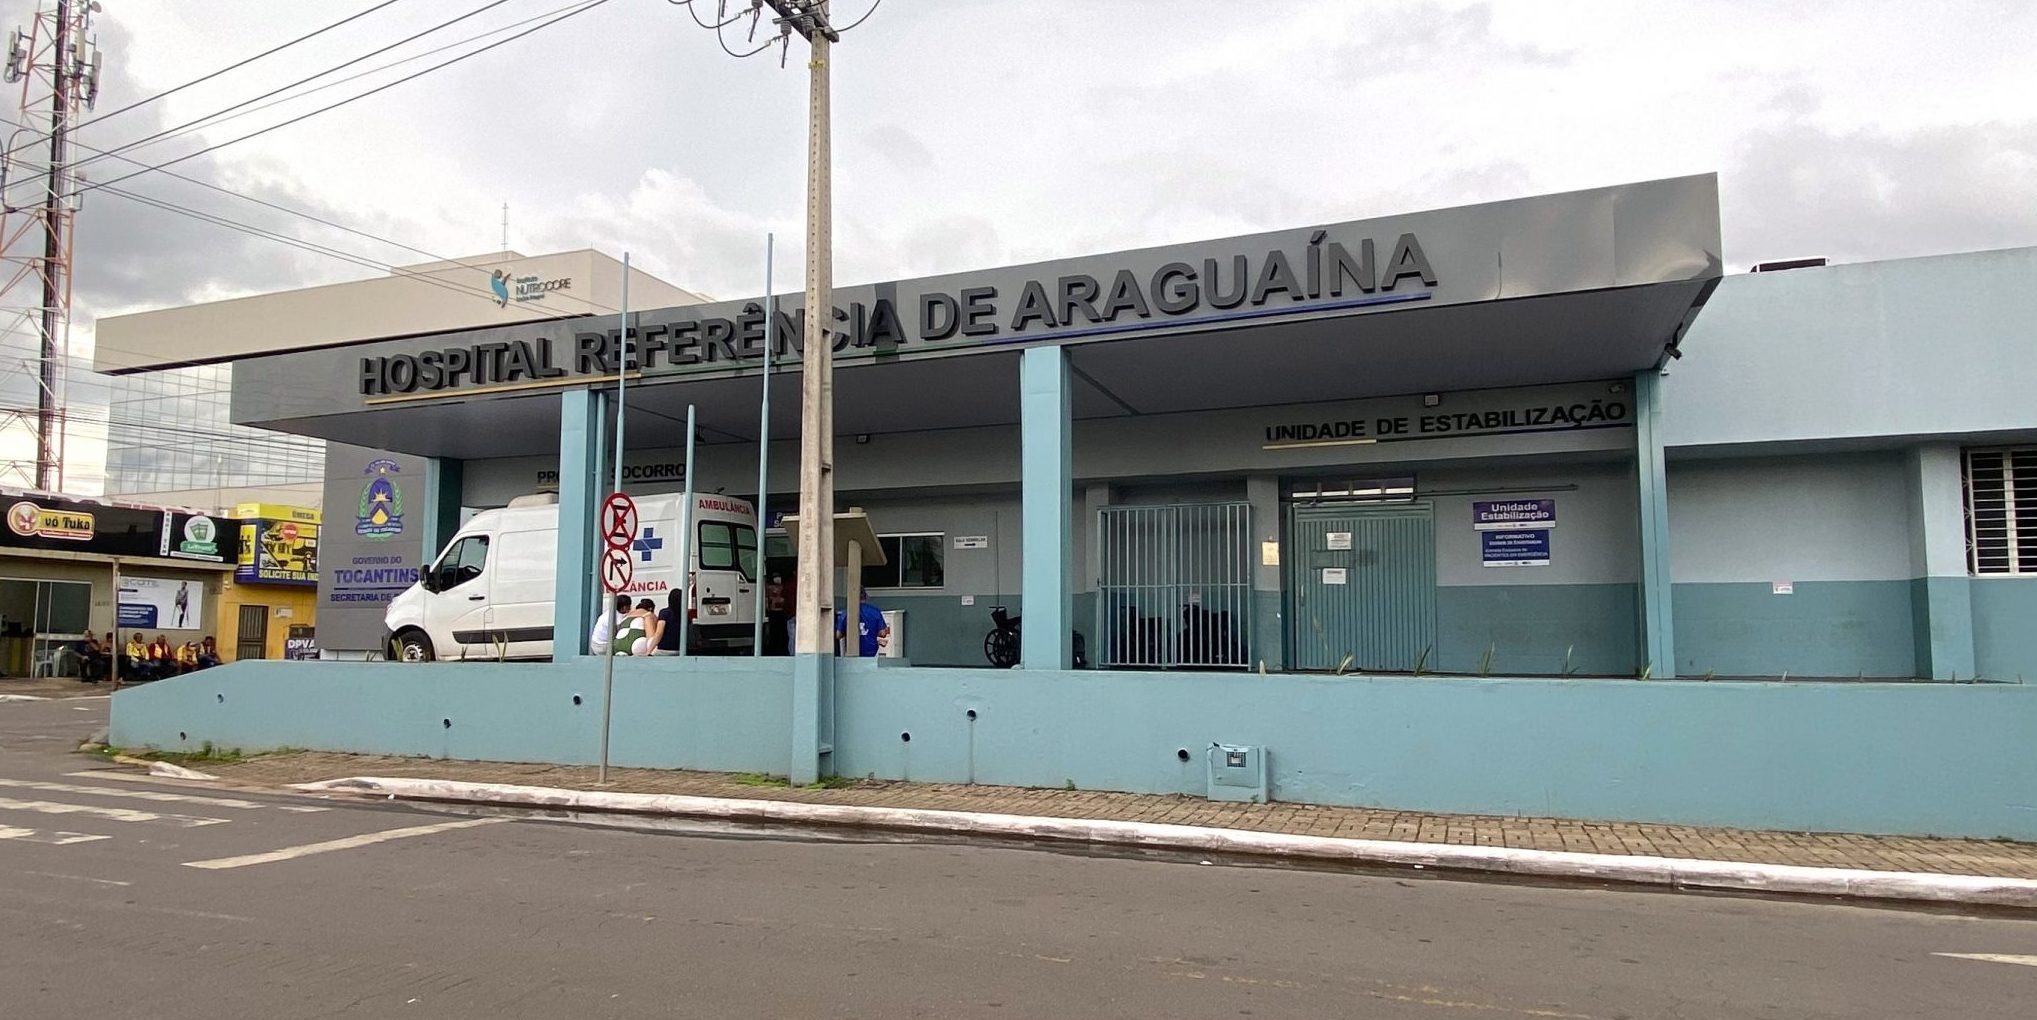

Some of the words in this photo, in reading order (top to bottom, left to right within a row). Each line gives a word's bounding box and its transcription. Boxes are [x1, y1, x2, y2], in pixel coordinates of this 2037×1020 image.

[359, 338, 567, 395] HOSPITAL
[919, 286, 998, 340] DE
[1011, 230, 1438, 331] ARAGUAÍNA
[1265, 419, 1366, 442] UNIDADE
[1376, 416, 1408, 435] DE
[1420, 399, 1627, 434] ESTABILIZAÇÃO
[1491, 503, 1537, 512] Unidade
[1481, 511, 1549, 520] Estabilização
[62, 516, 90, 530] Tuka
[352, 556, 389, 565] GOVERNO
[389, 556, 402, 564] DO
[258, 569, 291, 579] SOLICITE
[292, 571, 306, 580] SUA
[334, 568, 419, 584] TOCANTINS
[330, 593, 379, 602] SECRETARIA
[380, 593, 392, 601] DE
